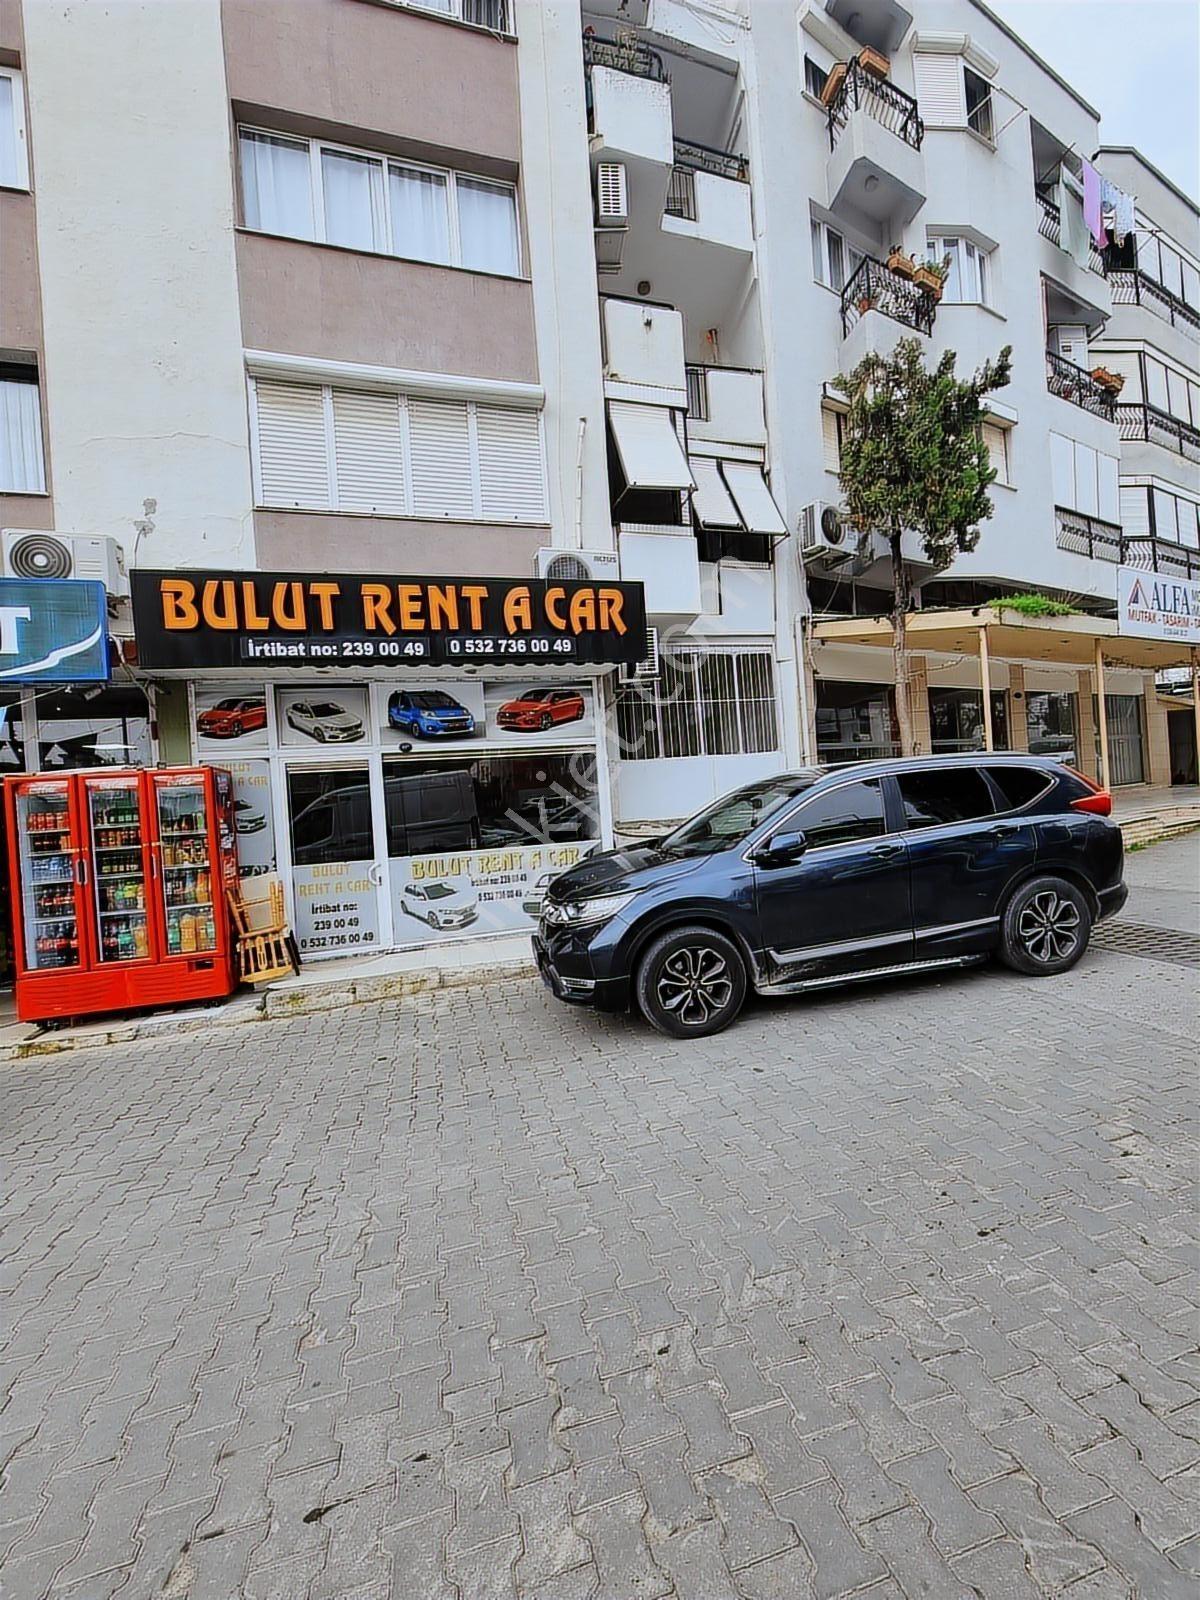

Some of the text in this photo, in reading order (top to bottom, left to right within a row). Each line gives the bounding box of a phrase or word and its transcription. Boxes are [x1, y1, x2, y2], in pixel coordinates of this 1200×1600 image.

[1151, 581, 1191, 616] ALFA
[160, 579, 627, 636] BULUT RENT A CAR
[1128, 608, 1157, 624] MUTFAK
[247, 639, 424, 657] İrtibat no: 239 00 49
[450, 639, 571, 653] 0 532 736 00 49
[312, 864, 351, 877] BULUT
[412, 856, 472, 880] BULUT
[478, 852, 524, 874] RENT
[549, 847, 580, 868] CAR
[298, 880, 370, 896] RENT A CAR
[343, 903, 358, 912] no:
[314, 917, 359, 931] 239 00 49
[301, 939, 307, 949] 0
[309, 937, 327, 948] 532
[348, 933, 360, 943] 00
[362, 932, 374, 941] 49
